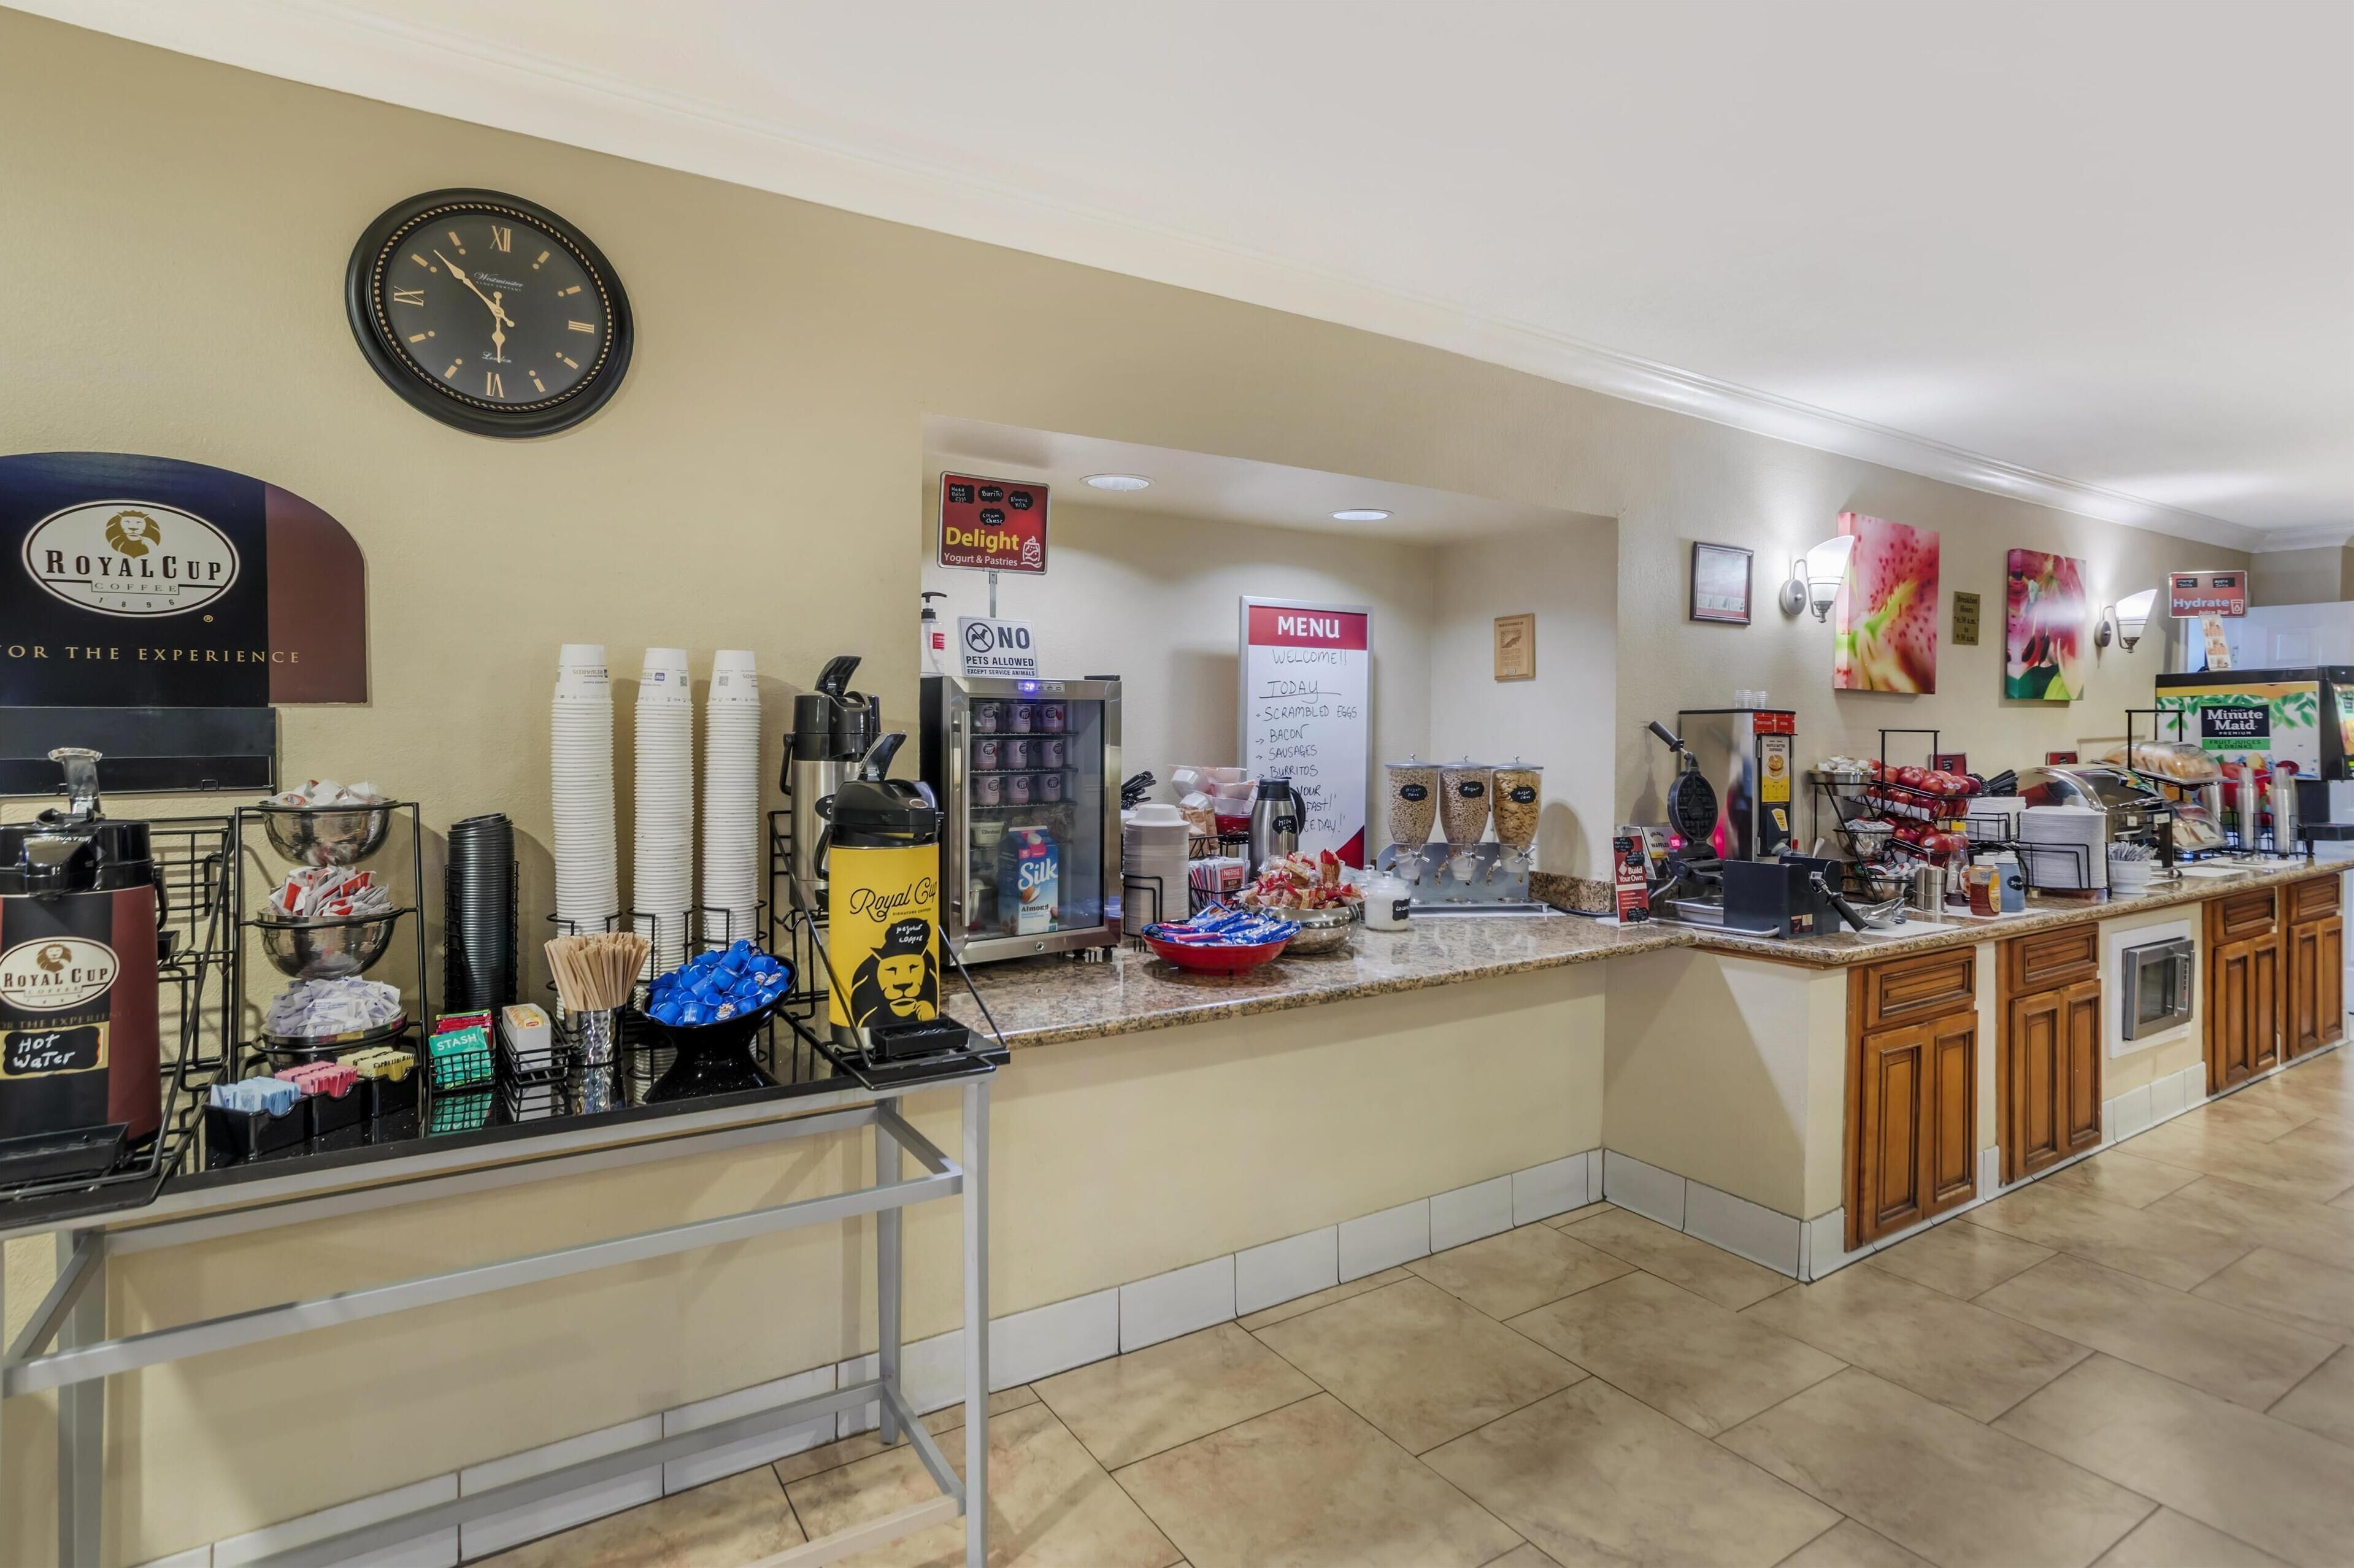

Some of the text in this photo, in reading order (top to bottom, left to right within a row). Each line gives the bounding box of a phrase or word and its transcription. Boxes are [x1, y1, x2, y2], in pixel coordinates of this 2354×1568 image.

[945, 527, 1019, 553] Delight
[944, 553, 1018, 566] Yogurt & Pastries
[94, 583, 177, 592] COFFEE
[2173, 598, 2229, 609] Hydrate
[1278, 616, 1340, 638] MENU
[998, 626, 1030, 649] NO
[0, 645, 299, 663] OR THE EXPERIENCE
[966, 656, 1034, 666] PETS ALLOWED
[1272, 649, 1347, 666] WELCOME!!
[1267, 680, 1318, 704] TODAY
[1263, 705, 1357, 721] SCRAMBLED EGGS
[2207, 709, 2264, 720] Minute
[2214, 720, 2256, 730] Maid
[1270, 724, 1309, 743] BACON
[1268, 745, 1318, 761] SAUSAGES
[1270, 764, 1318, 778] BURRITOS
[1296, 785, 1321, 796] YOUR
[1018, 858, 1058, 891] Silk
[1628, 866, 1642, 874] Build
[850, 877, 937, 922] Royal Cup
[4, 968, 108, 988] ROYAL CUP
[20, 1019, 46, 1029] THE
[437, 1033, 477, 1051] STASH
